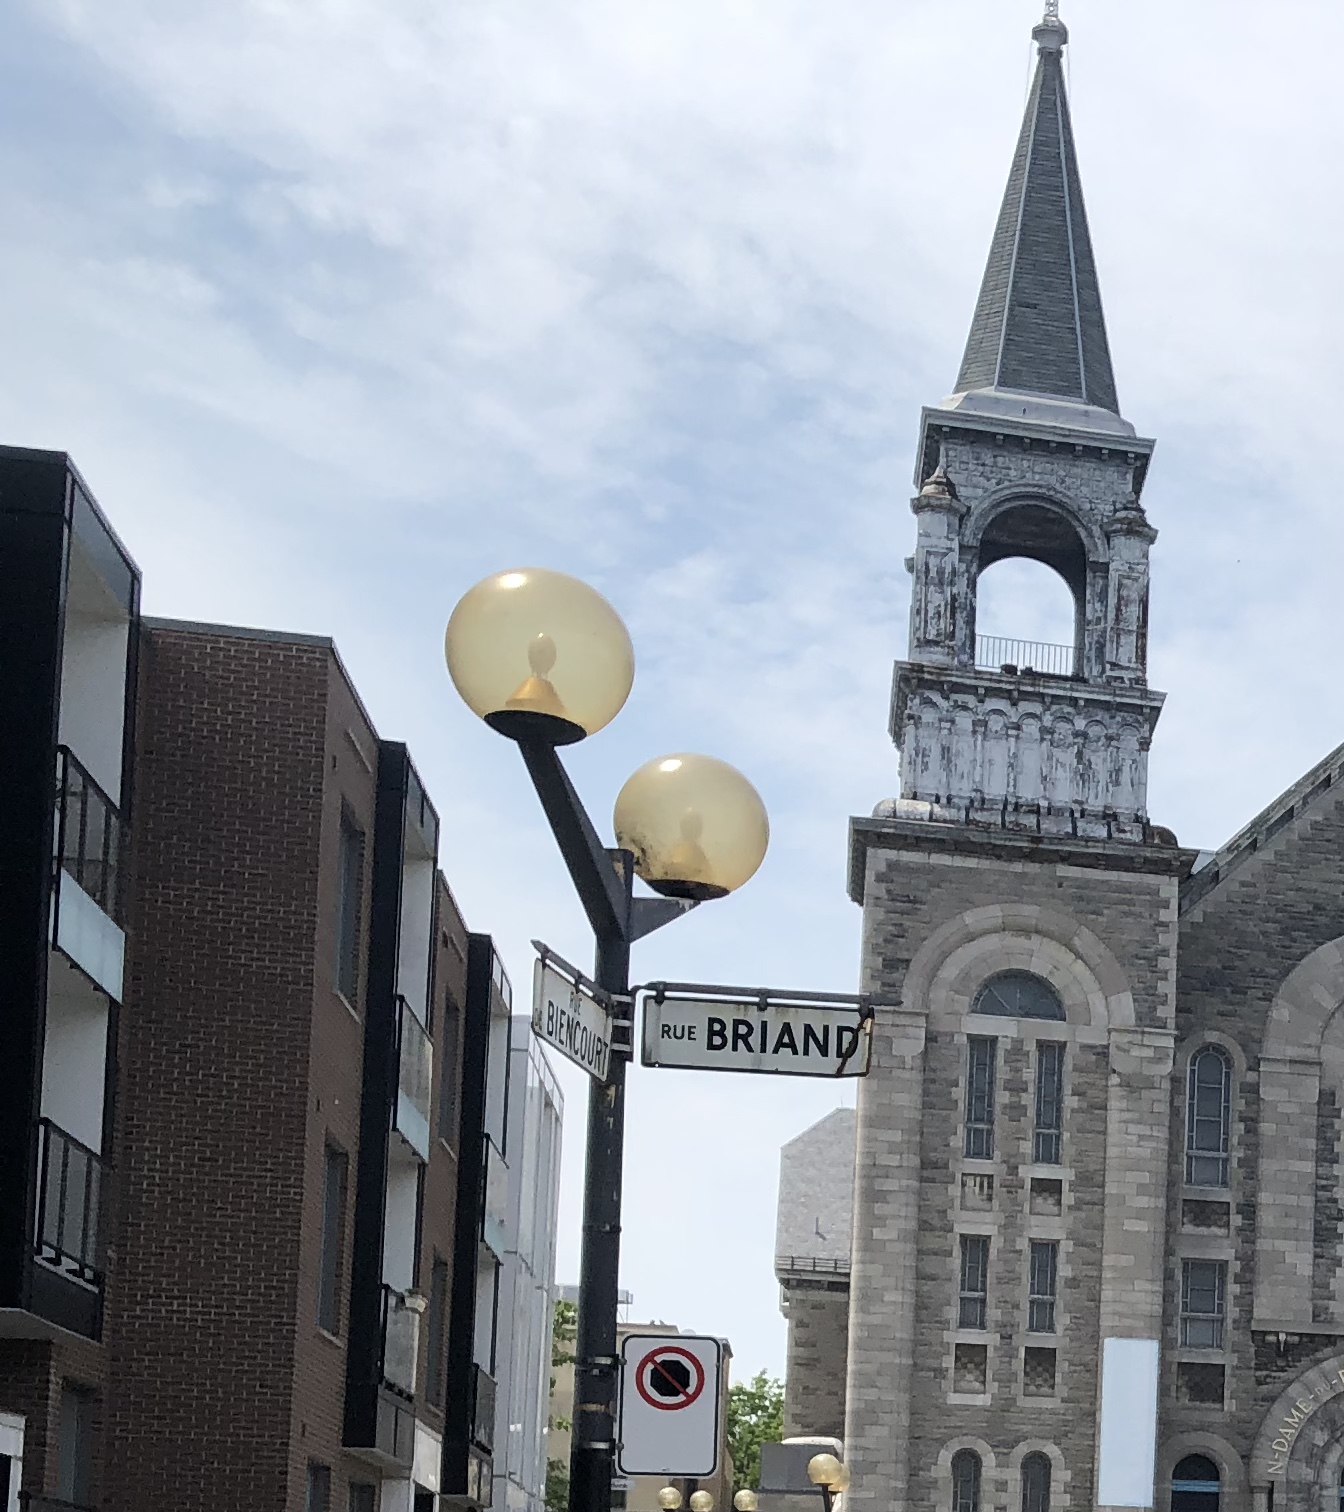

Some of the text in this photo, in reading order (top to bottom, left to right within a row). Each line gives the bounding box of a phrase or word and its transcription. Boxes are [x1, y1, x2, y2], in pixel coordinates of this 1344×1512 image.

[569, 990, 583, 1016] RUE
[546, 999, 609, 1076] BIENCOURT
[660, 1016, 859, 1060] RUE BRIAND
